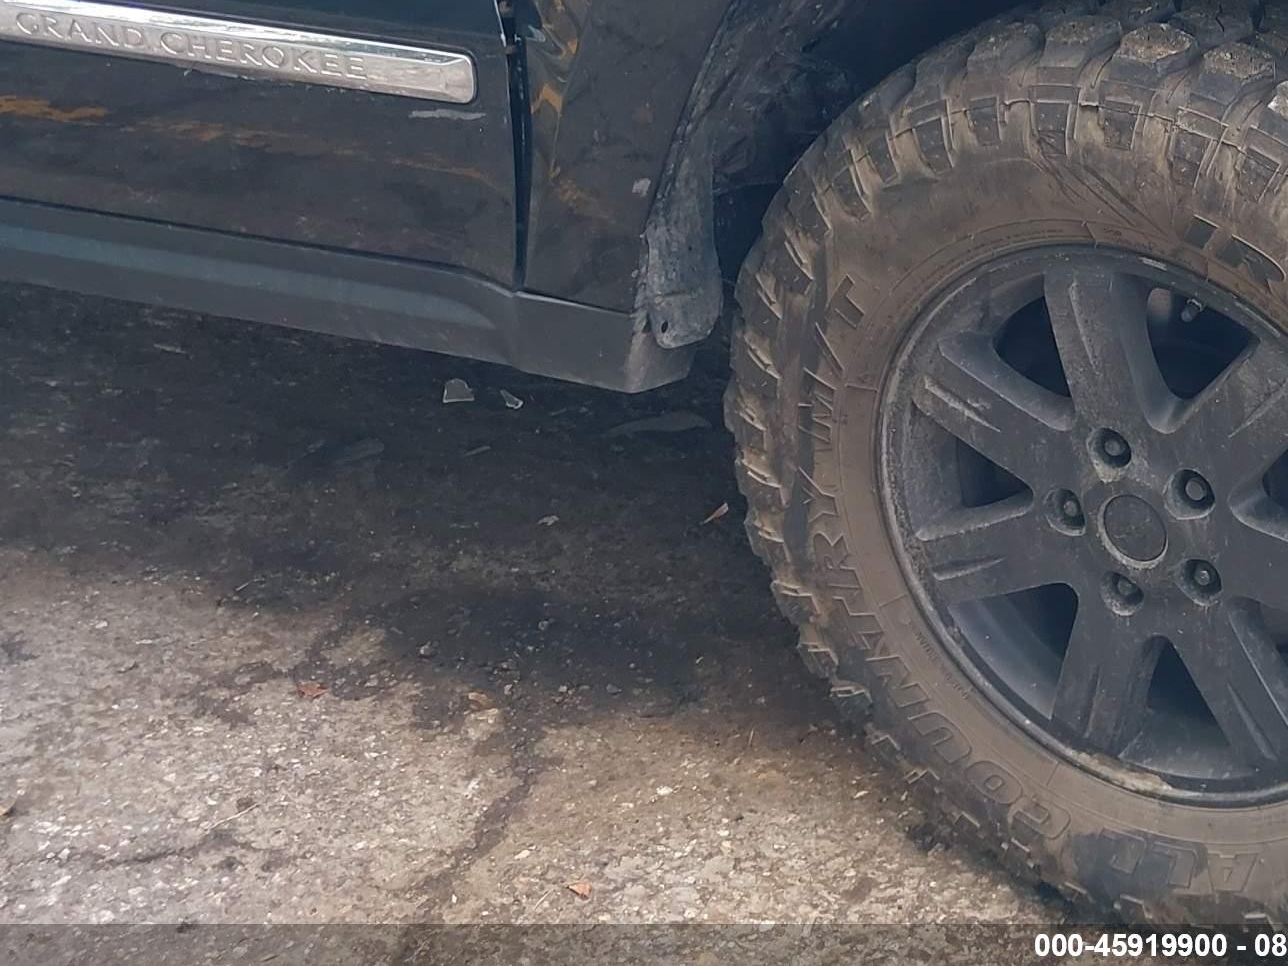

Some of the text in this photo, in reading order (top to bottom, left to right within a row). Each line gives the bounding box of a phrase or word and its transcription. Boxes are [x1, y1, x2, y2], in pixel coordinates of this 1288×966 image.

[15, 11, 366, 80] GRAND CHEROKEE
[799, 467, 1072, 840] COUNTRY
